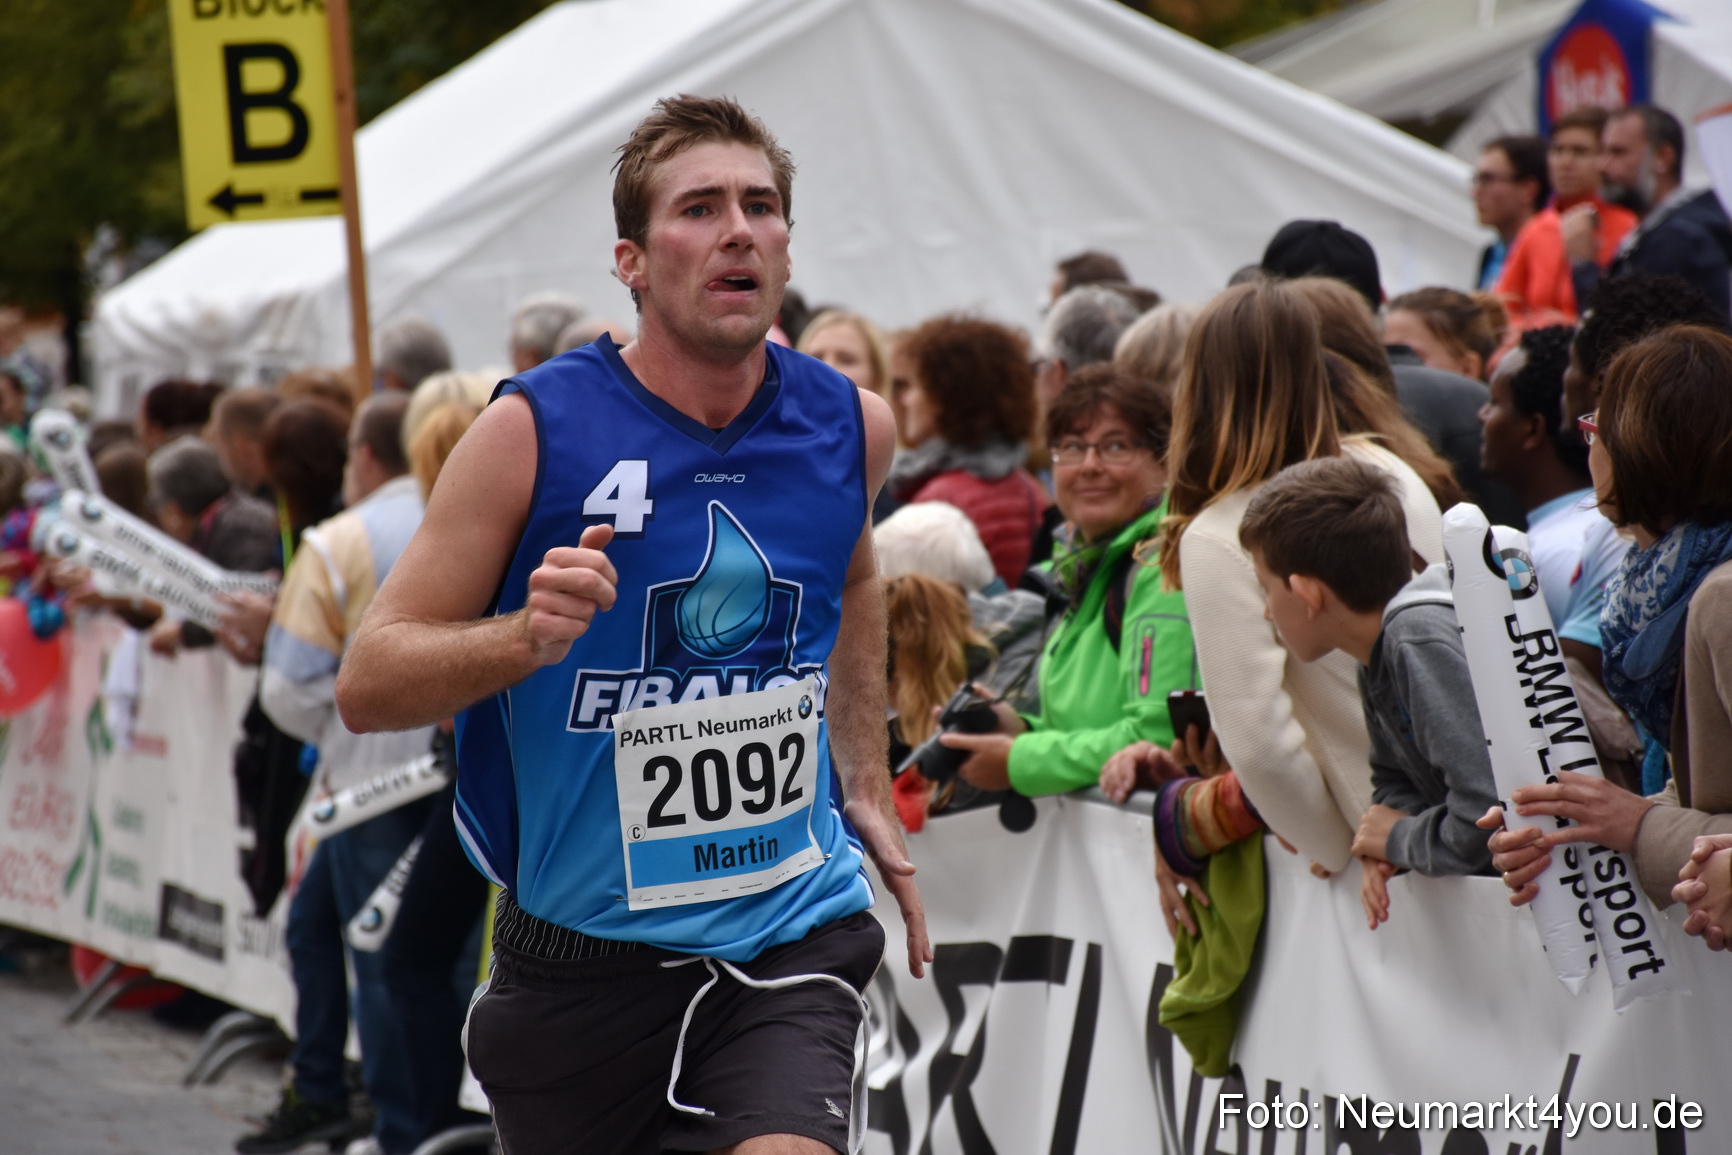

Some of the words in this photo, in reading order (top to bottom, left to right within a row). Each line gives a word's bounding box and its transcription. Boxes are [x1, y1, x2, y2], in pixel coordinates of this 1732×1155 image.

[222, 42, 311, 165] B
[582, 459, 653, 533] 4
[620, 723, 693, 748] PARTL
[697, 706, 793, 738] Neumarkt
[1522, 629, 1591, 745] BMW
[642, 732, 806, 829] 2092
[693, 835, 779, 873] Martin
